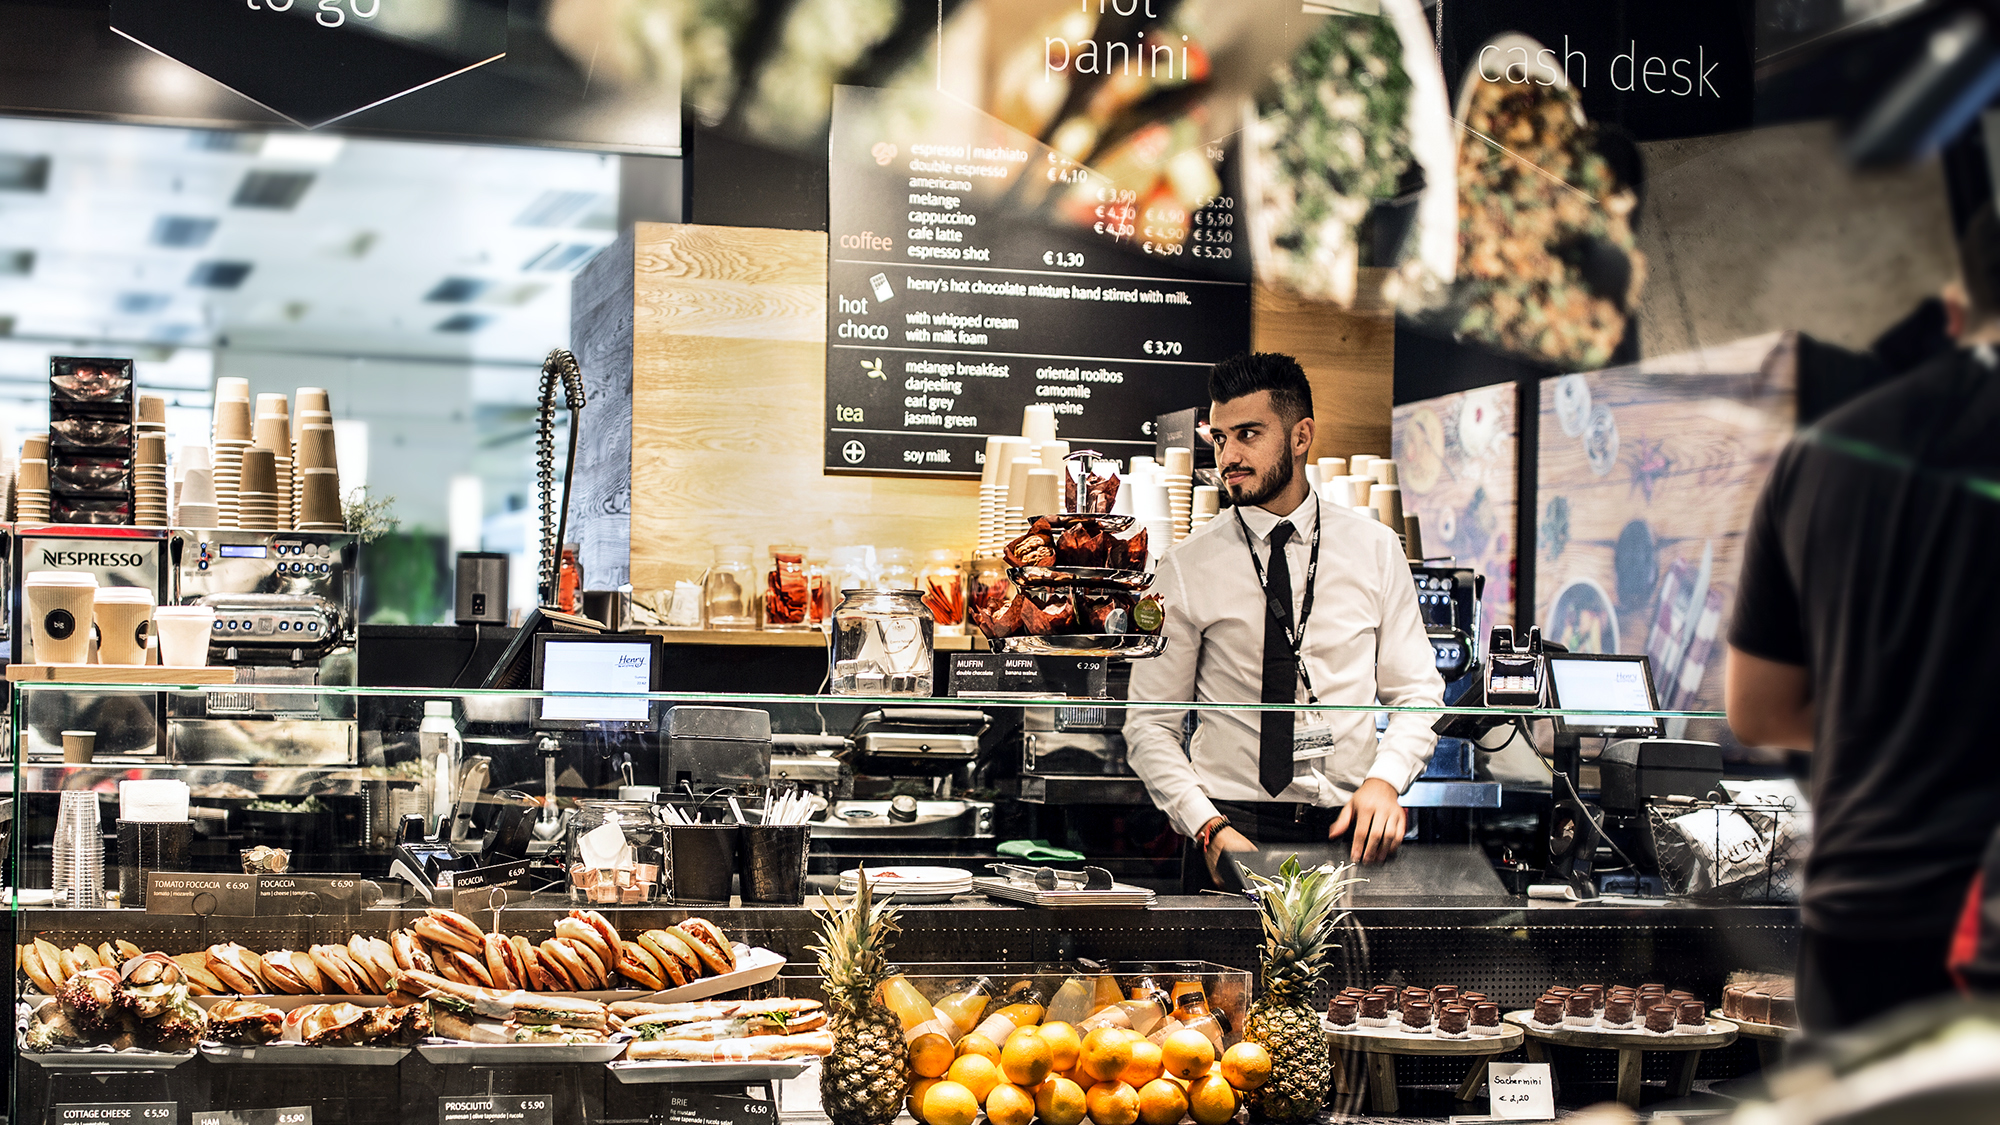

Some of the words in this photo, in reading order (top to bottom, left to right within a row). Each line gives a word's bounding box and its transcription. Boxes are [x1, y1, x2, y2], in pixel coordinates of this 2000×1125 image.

[1045, 31, 1188, 83] panini
[1478, 34, 1587, 88] cash
[1610, 39, 1720, 98] desk
[910, 143, 964, 160] espresso
[973, 147, 1028, 163] machiato
[1207, 146, 1224, 162] big
[910, 159, 952, 174] double
[954, 162, 1007, 178] espresso
[1059, 170, 1088, 184] 4,10
[908, 176, 972, 192] americano
[908, 192, 961, 210] melange
[907, 211, 977, 226] cappuccino
[839, 231, 893, 251] coffee
[907, 226, 934, 241] cafe
[935, 227, 963, 242] latte
[907, 245, 961, 260] espresso
[962, 246, 990, 261] shot
[1043, 251, 1054, 266] €
[1056, 252, 1085, 268] 1,30
[906, 276, 949, 294] henry's
[950, 278, 970, 293] hot
[971, 280, 1027, 296] chocolate
[1028, 283, 1070, 299] mixture
[1071, 285, 1101, 300] hand
[1102, 287, 1138, 303] stirred
[1139, 289, 1163, 303] with
[838, 294, 868, 315] hot
[905, 310, 931, 325] with
[932, 311, 982, 329] whipped
[983, 316, 1019, 330] cream
[837, 319, 889, 340] choco
[905, 328, 930, 342] with
[932, 329, 958, 344] milk
[958, 330, 988, 345] foam
[1143, 340, 1153, 354] €
[1155, 340, 1183, 356] 3,70
[905, 360, 955, 377] melange
[956, 361, 1010, 378] breakfast
[1035, 366, 1080, 381] oriental
[1080, 368, 1124, 384] rooibos
[904, 376, 963, 395] darjeeling
[1035, 384, 1091, 399] camomile
[904, 394, 927, 408] earl
[928, 397, 955, 411] grey
[836, 404, 864, 423] tea
[903, 411, 942, 427] jasmin
[944, 415, 977, 429] green
[903, 450, 925, 465] soy
[925, 449, 951, 463] milk
[40, 548, 143, 568] NESPRESSO
[619, 655, 645, 668] Henry
[956, 660, 984, 668] MUFFIN
[1005, 659, 1033, 668] MUFFIN
[1077, 662, 1083, 670] €
[154, 880, 185, 888] TOMATO
[185, 880, 221, 889] FOCCACIA
[225, 881, 232, 890] €
[260, 880, 295, 888] FOCACCIA
[330, 880, 337, 888] €
[1493, 1075, 1542, 1085] Sachermini
[63, 1109, 99, 1119] COTTAGE
[100, 1109, 132, 1119] CHEESE
[143, 1109, 150, 1118] €
[445, 1101, 493, 1111] PROSCIUTTO
[520, 1101, 527, 1110] €
[671, 1097, 688, 1107] BRIE
[744, 1104, 750, 1113] €
[279, 1114, 286, 1123] €
